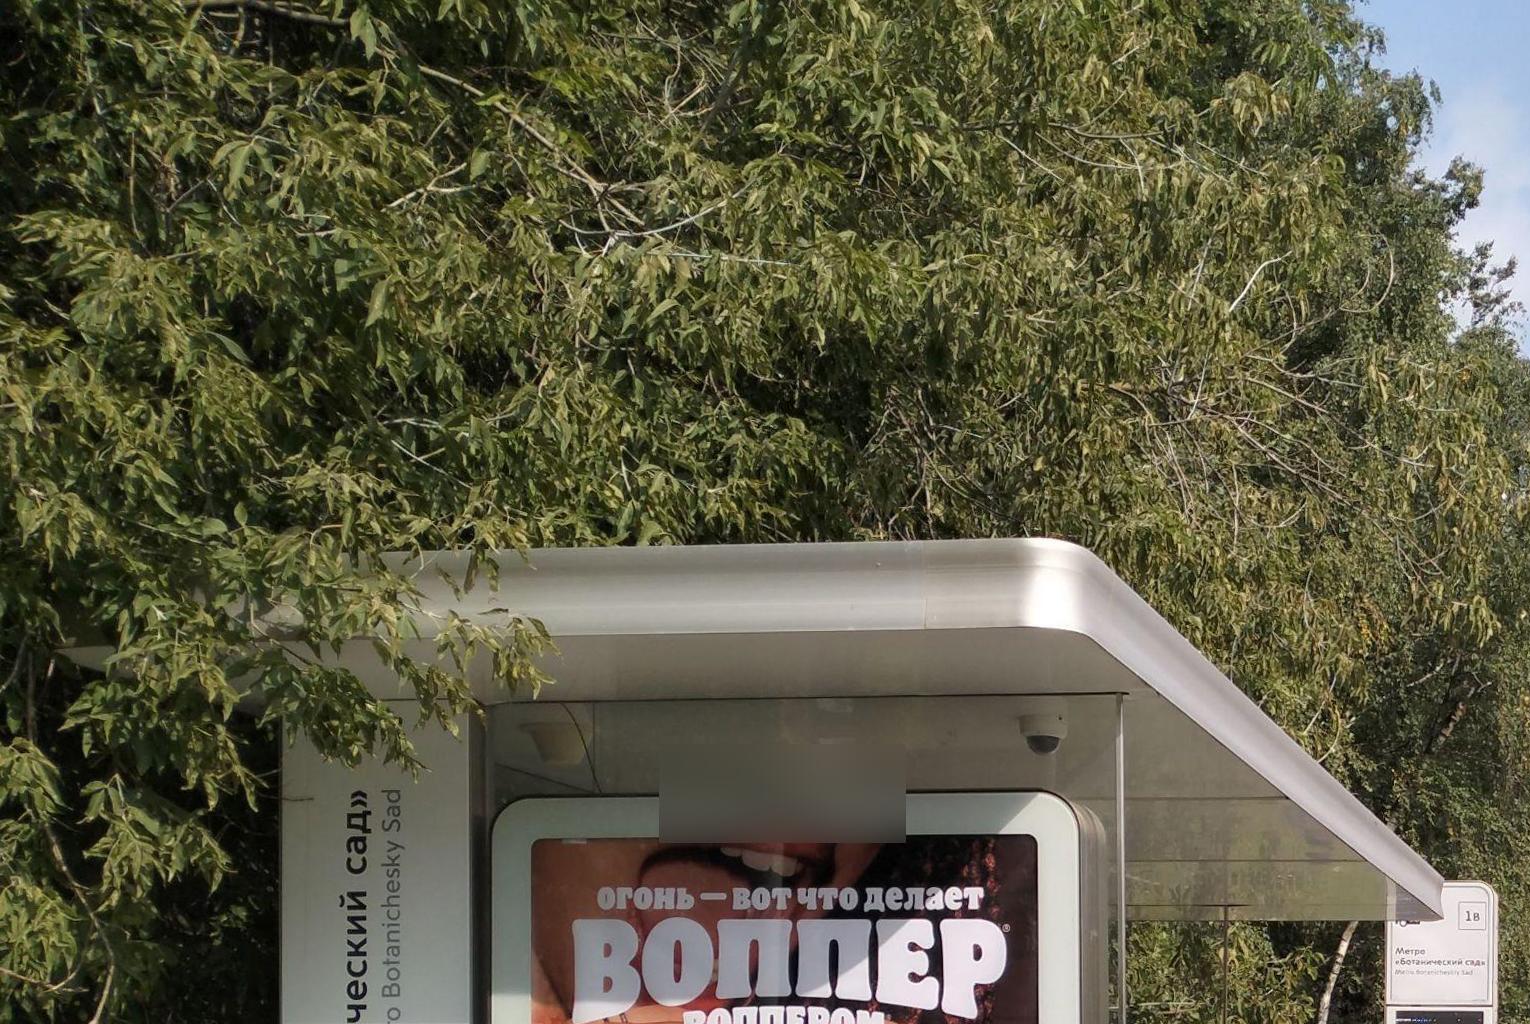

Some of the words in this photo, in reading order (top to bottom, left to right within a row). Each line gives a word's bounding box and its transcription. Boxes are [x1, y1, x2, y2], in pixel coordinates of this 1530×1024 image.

[346, 790, 372, 875] сад»
[381, 789, 401, 833] Sad
[381, 840, 405, 998] Botanichesky
[597, 886, 695, 911] огонь
[732, 886, 792, 911] вот
[797, 886, 859, 911] что
[863, 886, 985, 913] делает
[1395, 947, 1426, 956] Метро
